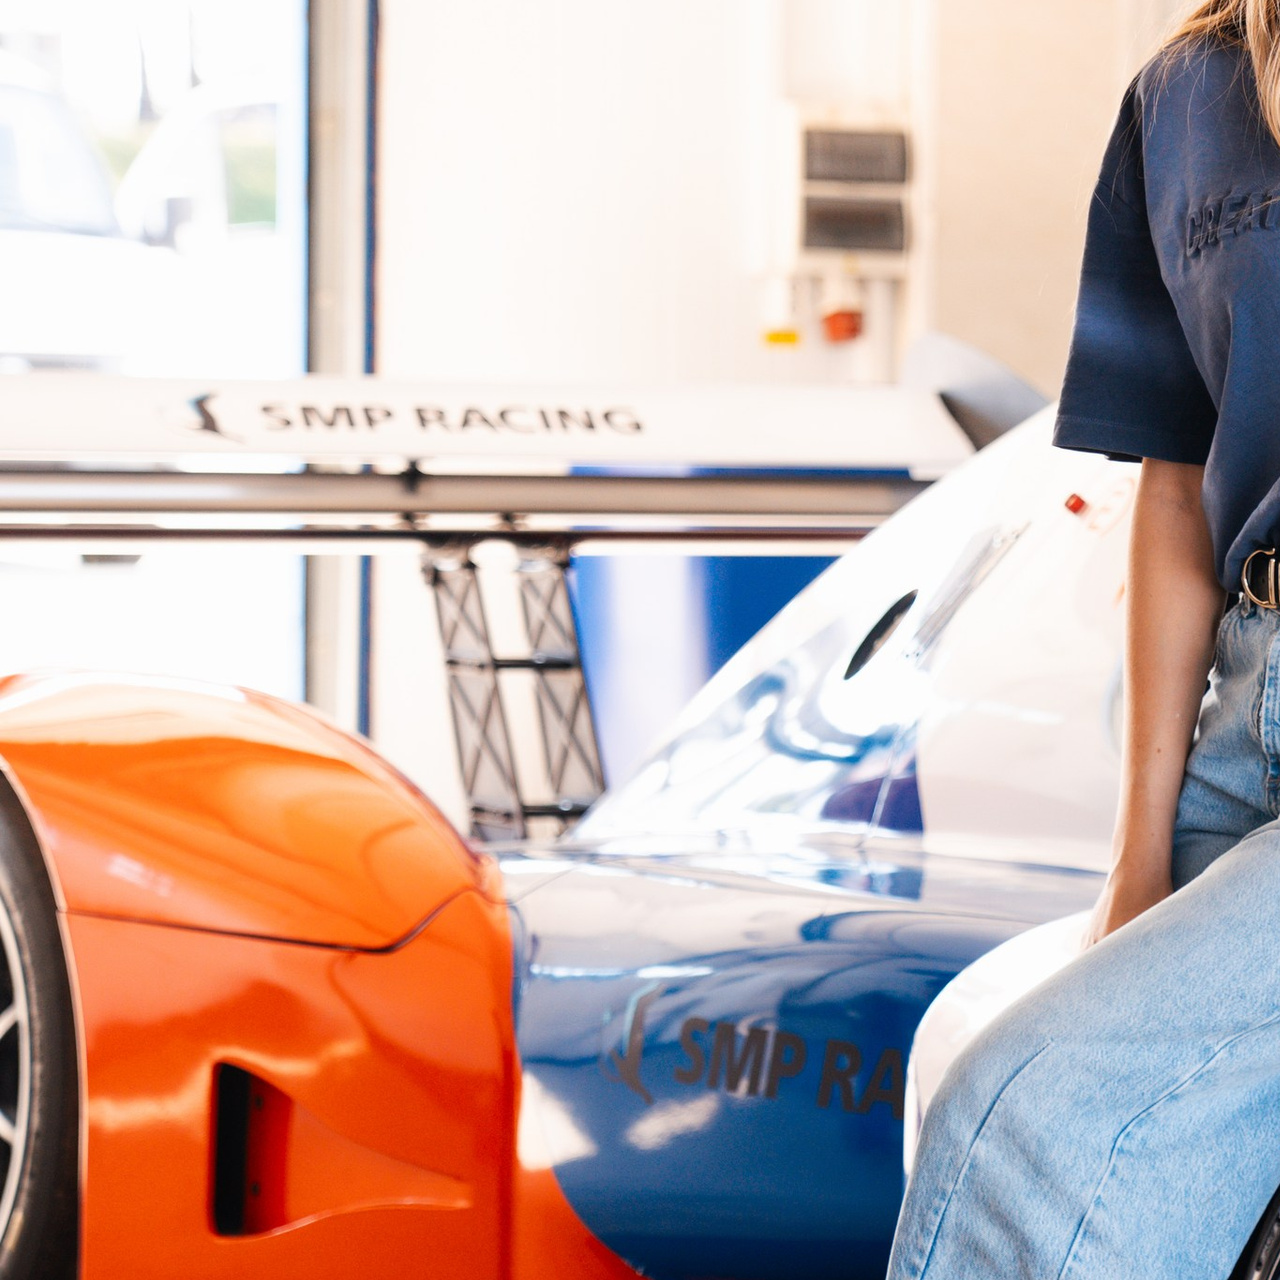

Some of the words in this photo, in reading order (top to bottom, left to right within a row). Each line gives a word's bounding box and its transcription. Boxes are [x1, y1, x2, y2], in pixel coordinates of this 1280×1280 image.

[260, 404, 393, 432] SMP
[414, 405, 645, 435] RACING
[674, 1016, 807, 1100] SMP
